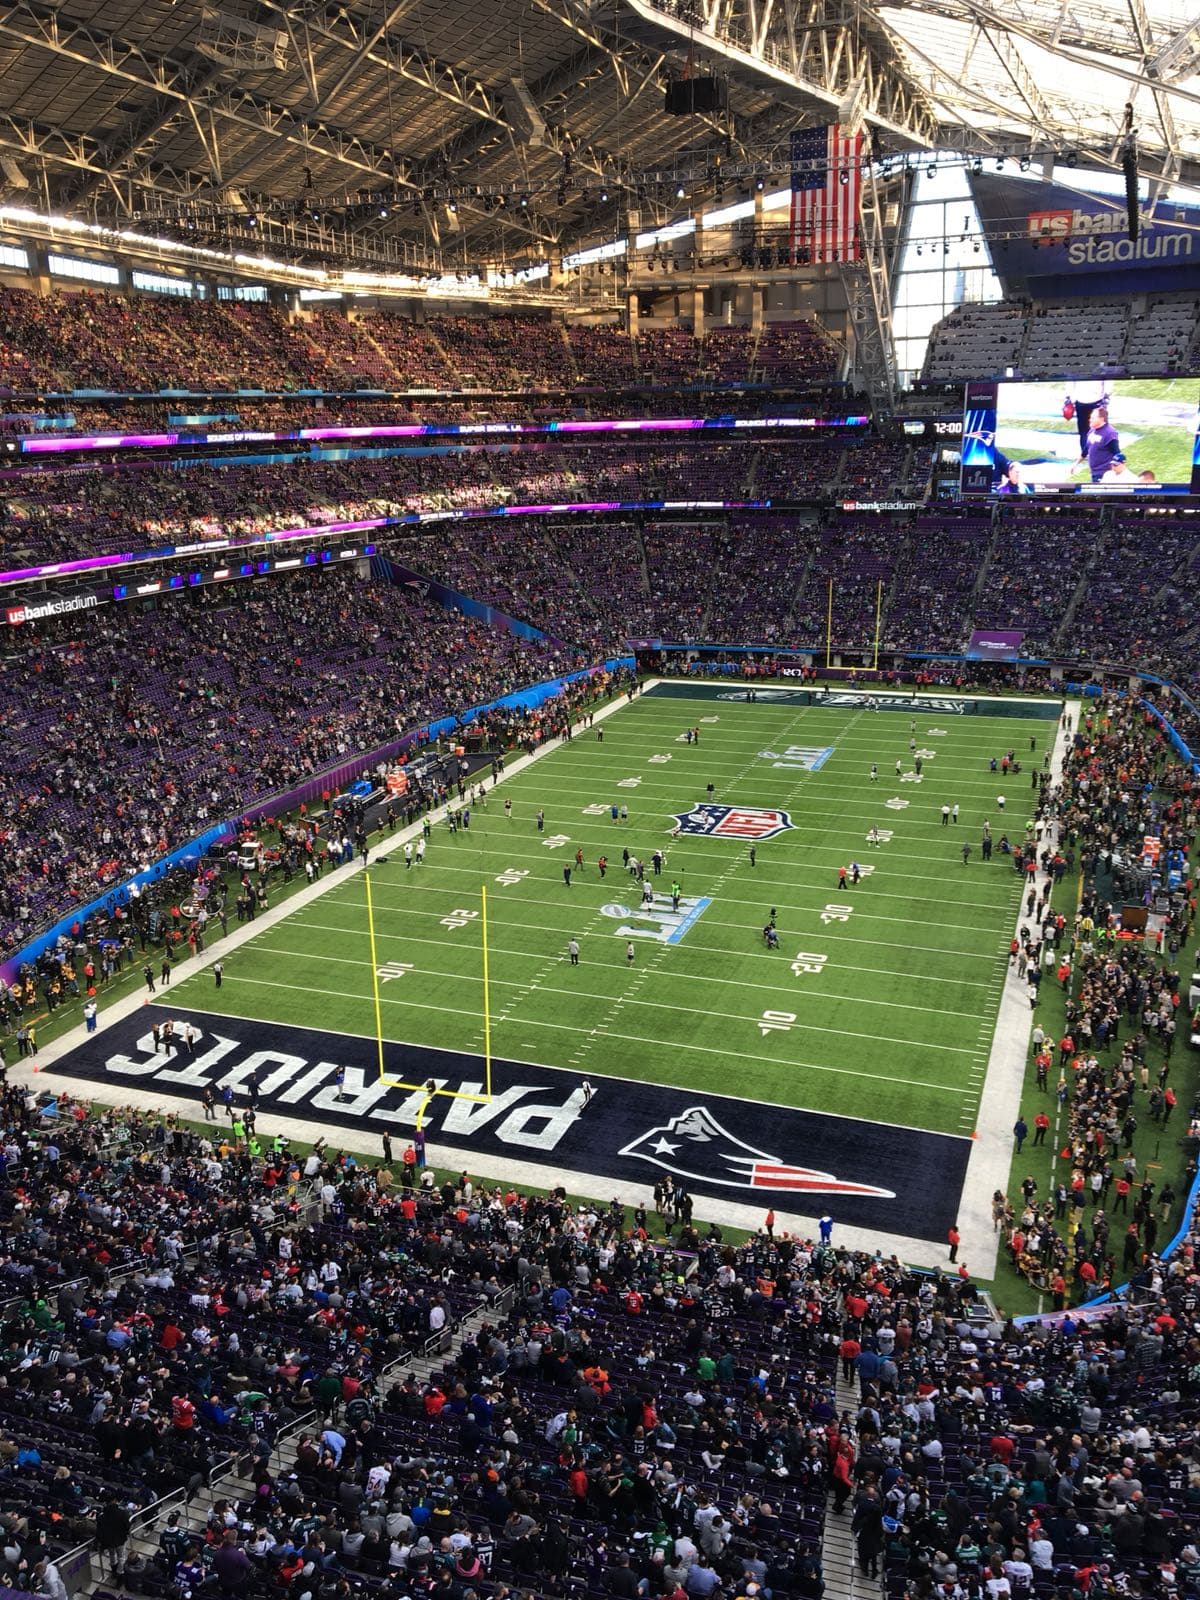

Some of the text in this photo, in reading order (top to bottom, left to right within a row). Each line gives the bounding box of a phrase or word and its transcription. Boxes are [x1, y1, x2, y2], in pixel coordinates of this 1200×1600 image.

[715, 811, 781, 837] NFL
[494, 868, 530, 884] 30
[439, 909, 479, 927] 20
[819, 904, 854, 921] 30
[375, 961, 415, 979] 10
[790, 952, 828, 973] 20
[757, 1010, 797, 1031] 10
[104, 1020, 598, 1151] PATRIOTS
[991, 1391, 1002, 1401] 14
[367, 1477, 381, 1491] 54
